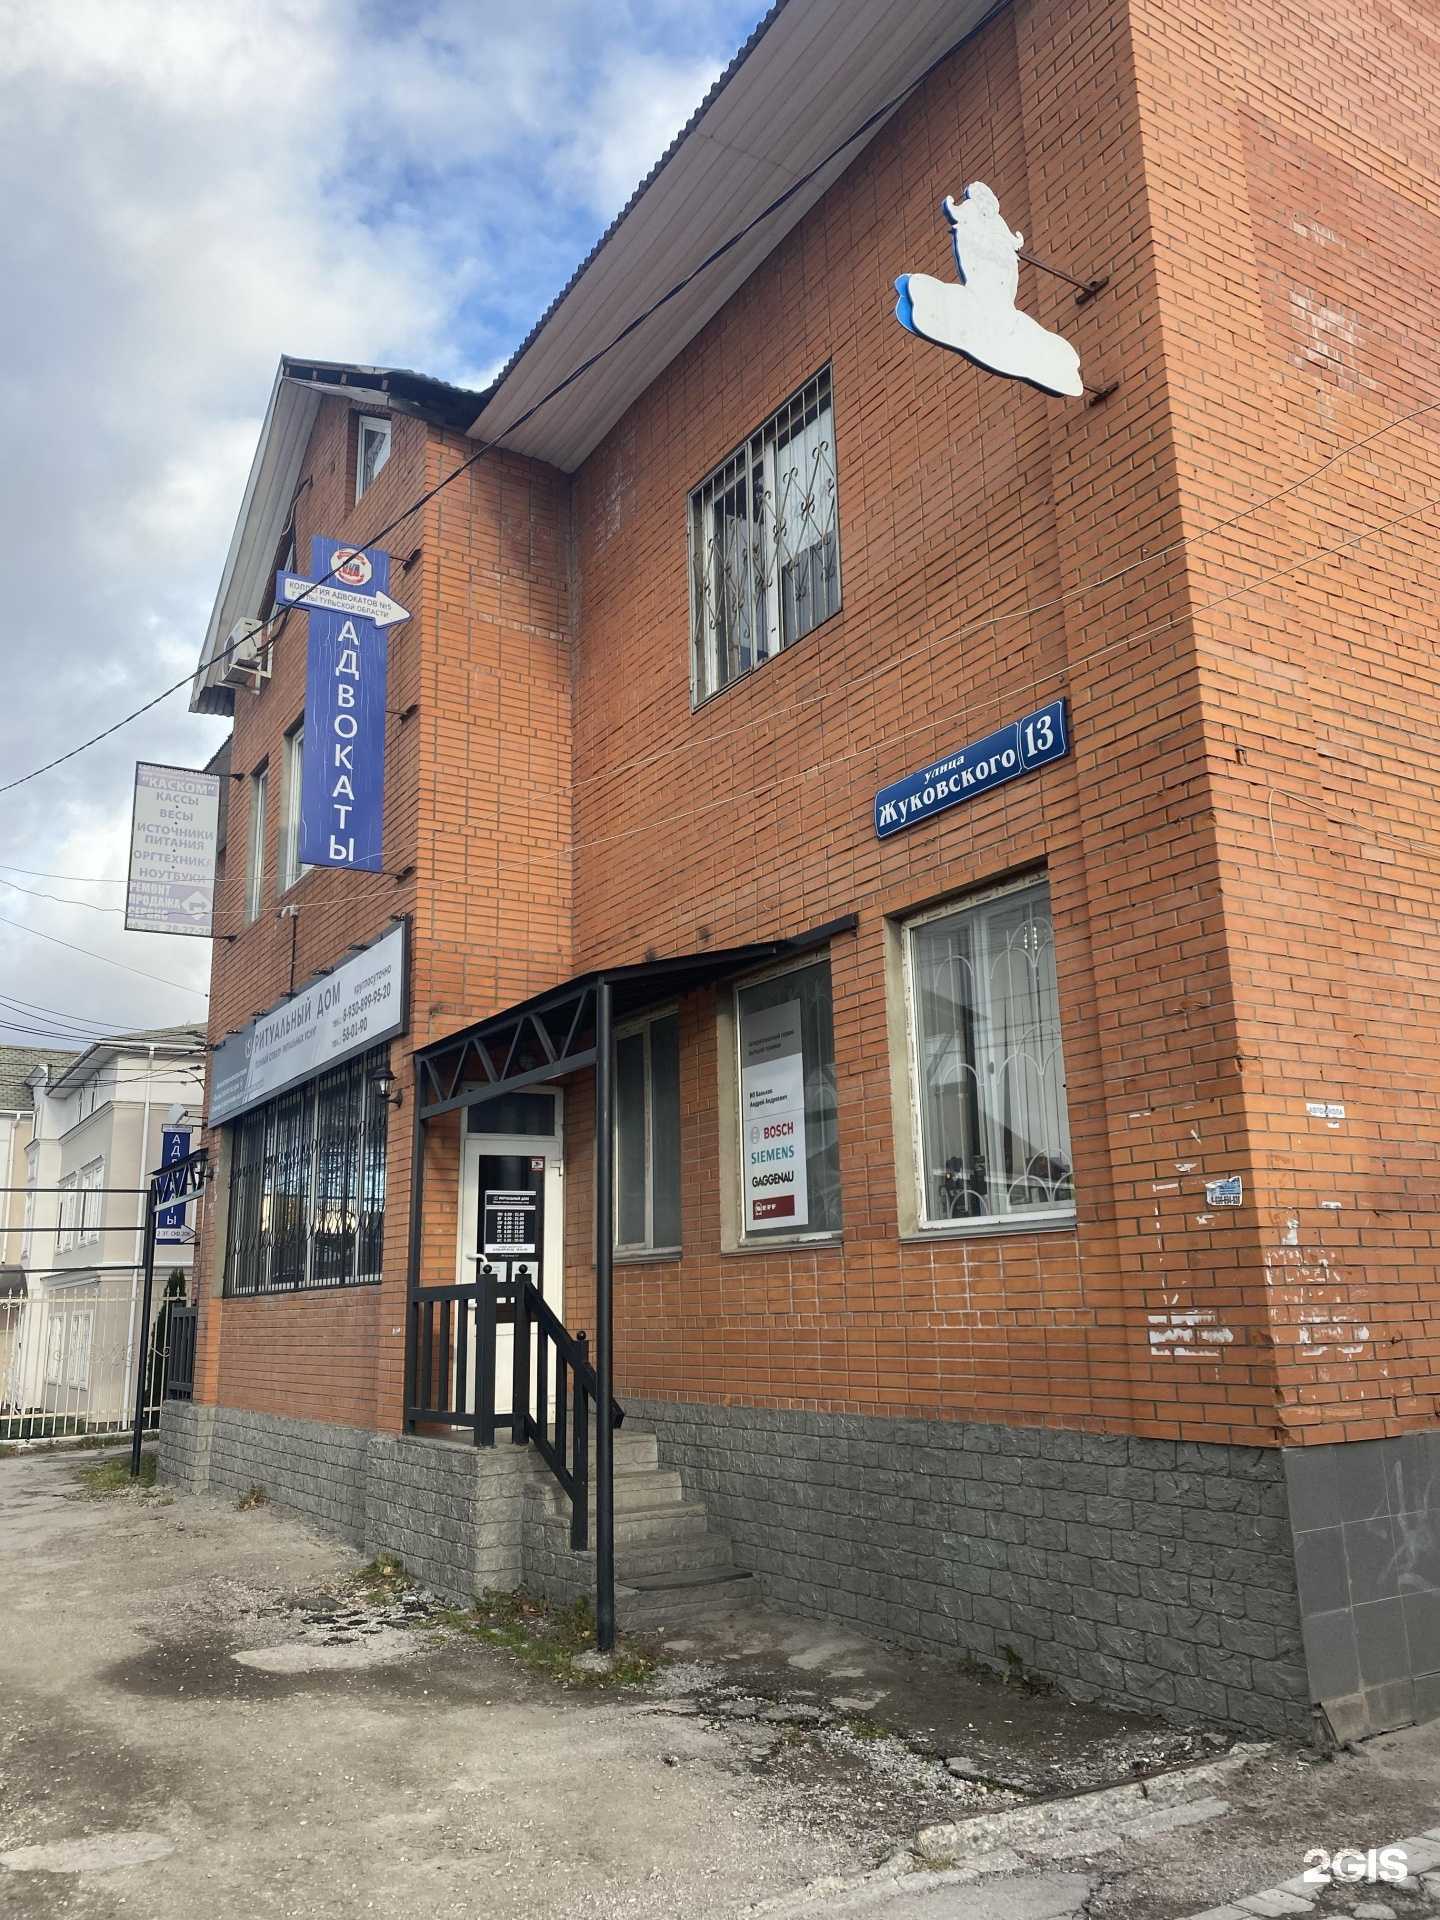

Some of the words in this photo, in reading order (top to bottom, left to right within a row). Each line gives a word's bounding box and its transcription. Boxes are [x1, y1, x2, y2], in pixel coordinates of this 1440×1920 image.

[320, 597, 357, 611] ТУЛЬСКОЙ
[357, 605, 390, 618] ОБЛАСТИ
[332, 591, 378, 608] АДВОКАТОВ
[328, 620, 361, 862] АДВОКАТЫ
[878, 749, 1016, 828] Жуковского
[1025, 715, 1055, 758] 13
[923, 754, 965, 785] улица
[156, 791, 199, 806] КАССЫ
[160, 808, 193, 822] ВЕСЫ
[137, 822, 214, 841] ИСТОЧНИКИ
[144, 835, 205, 850] ПИТАНИЯ
[254, 996, 312, 1055] РИТУАЛЬНЫЙ
[316, 981, 342, 1019] ДОМ
[763, 1121, 795, 1140] BOSCH
[751, 1144, 795, 1165] SIEMENS
[166, 1134, 181, 1225] АДКАТЫ
[751, 1170, 795, 1188] GAGGENAU
